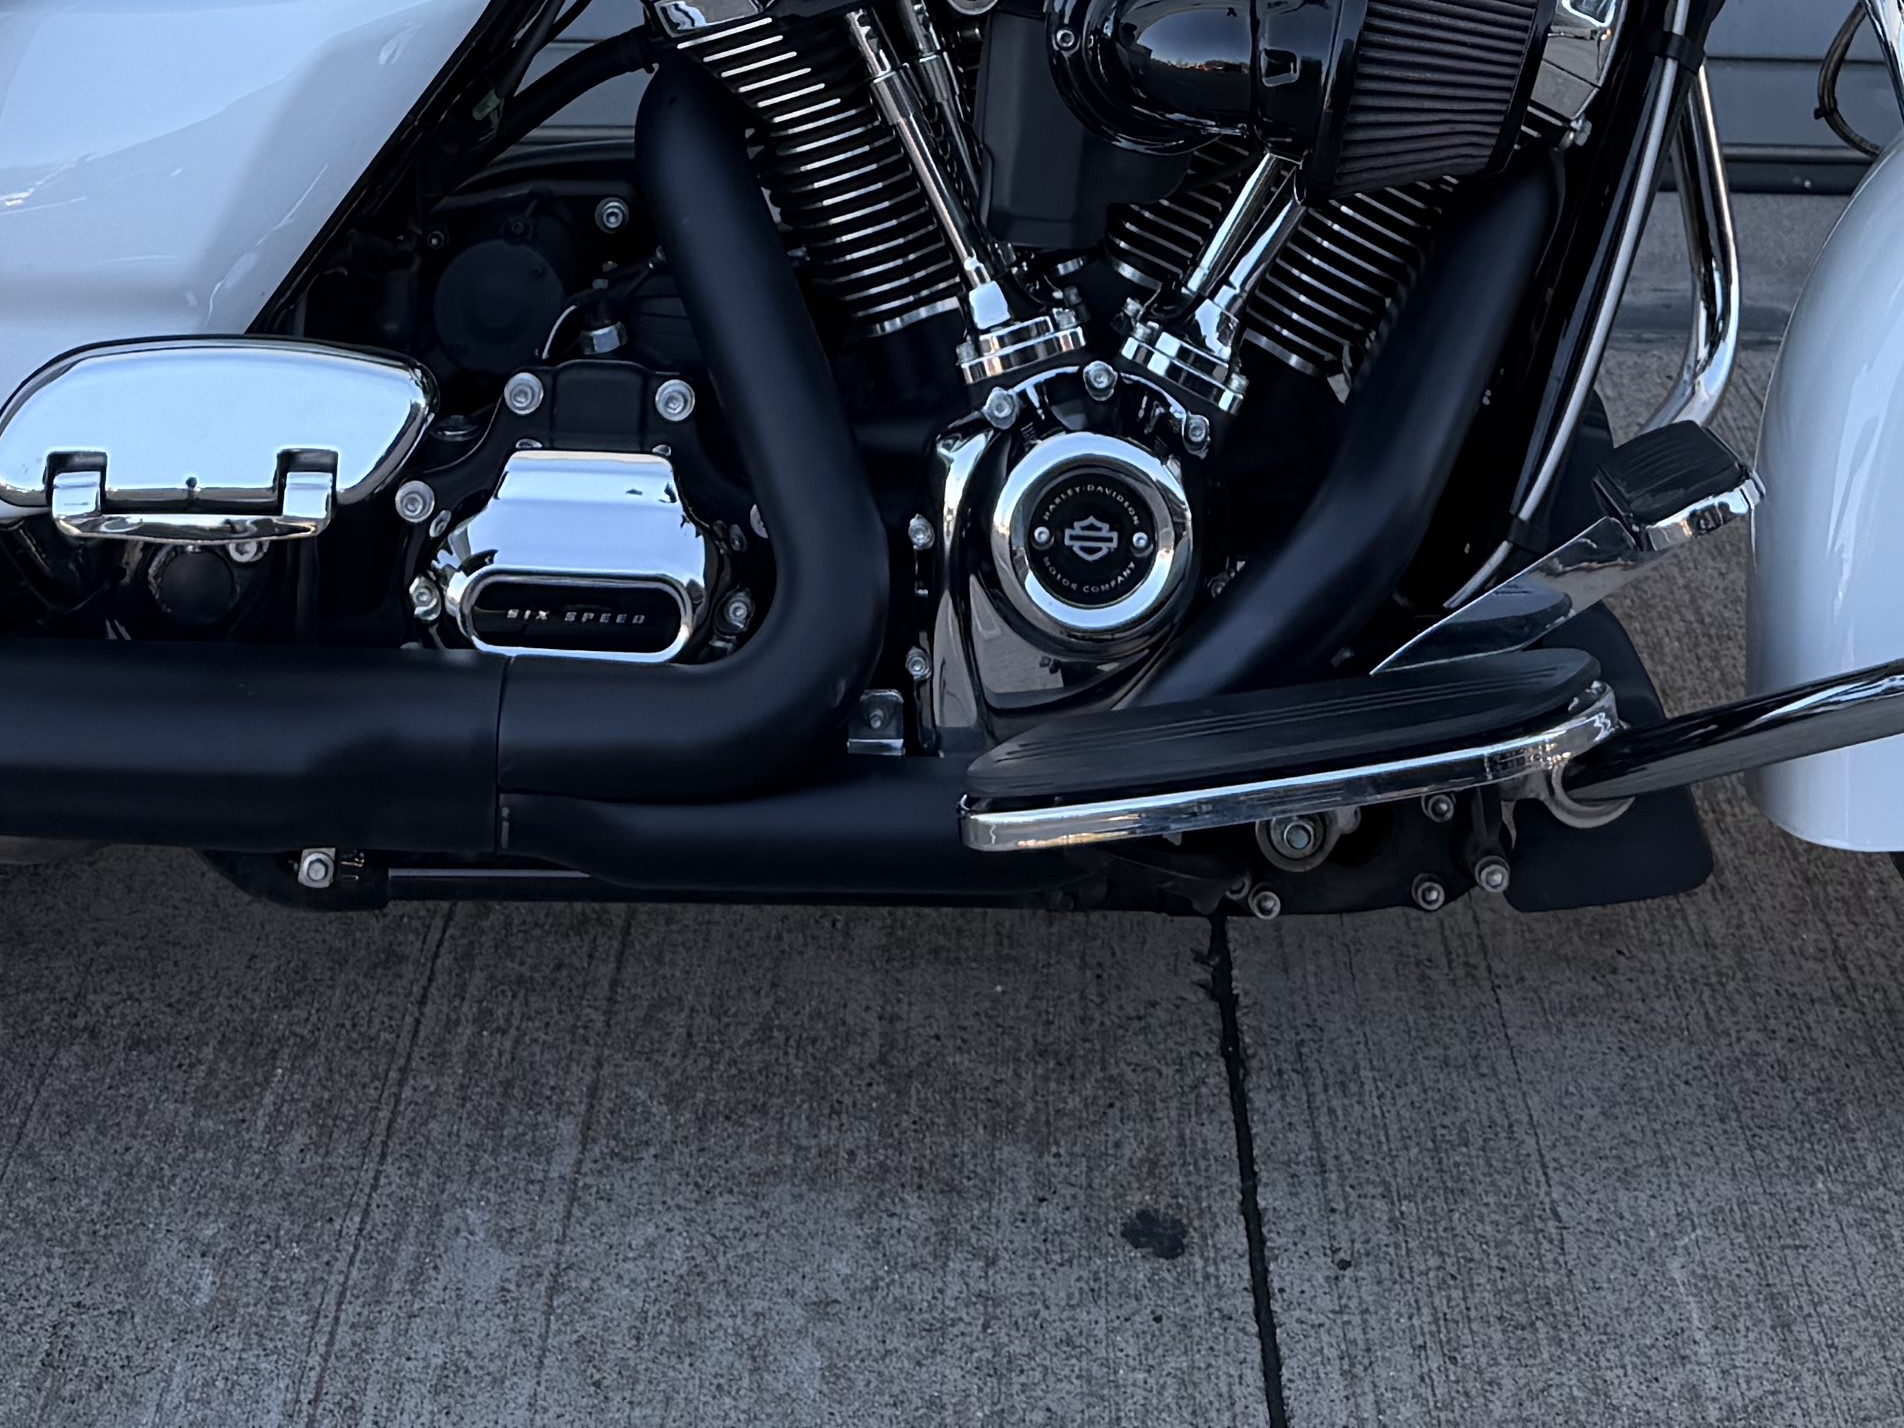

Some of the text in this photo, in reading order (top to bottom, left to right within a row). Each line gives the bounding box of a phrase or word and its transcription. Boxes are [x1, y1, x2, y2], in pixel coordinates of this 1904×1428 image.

[1042, 556, 1137, 593] MOTOR COMPANY
[507, 608, 645, 624] SIX SPEED
